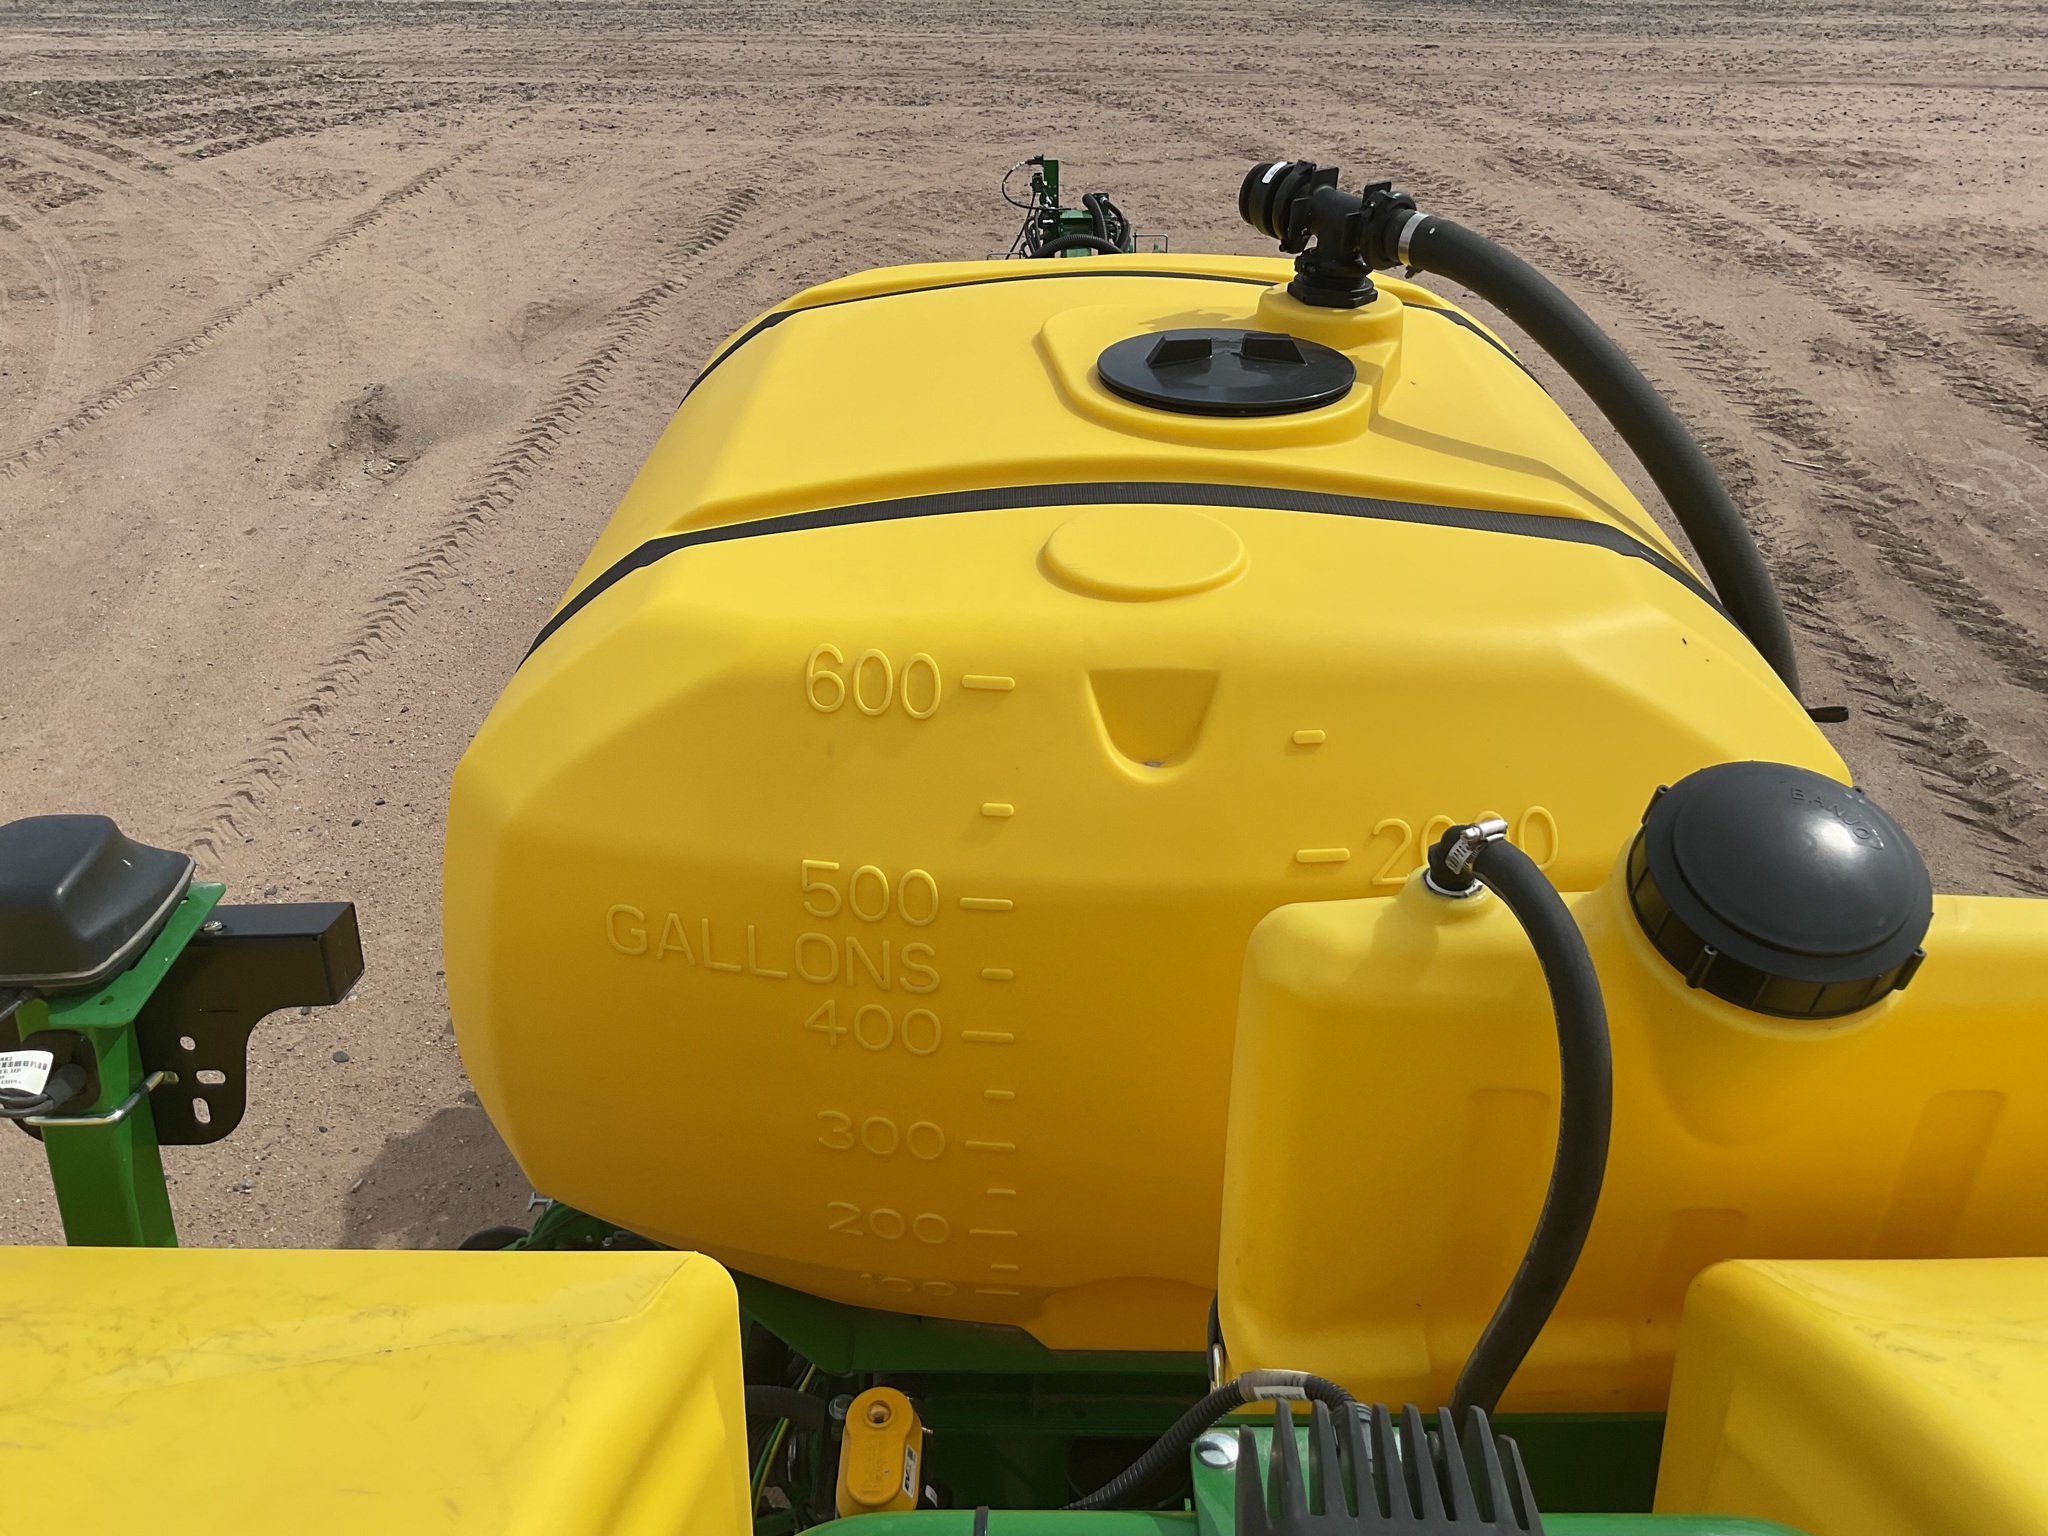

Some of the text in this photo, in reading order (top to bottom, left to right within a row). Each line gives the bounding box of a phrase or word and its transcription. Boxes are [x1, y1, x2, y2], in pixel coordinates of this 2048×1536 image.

[806, 644, 941, 720] 600
[1372, 806, 1559, 884] 200
[802, 859, 939, 926] 500
[605, 904, 941, 993] GALLONS
[804, 999, 942, 1056] 400
[817, 1110, 946, 1160] 300
[827, 1201, 950, 1244] 200
